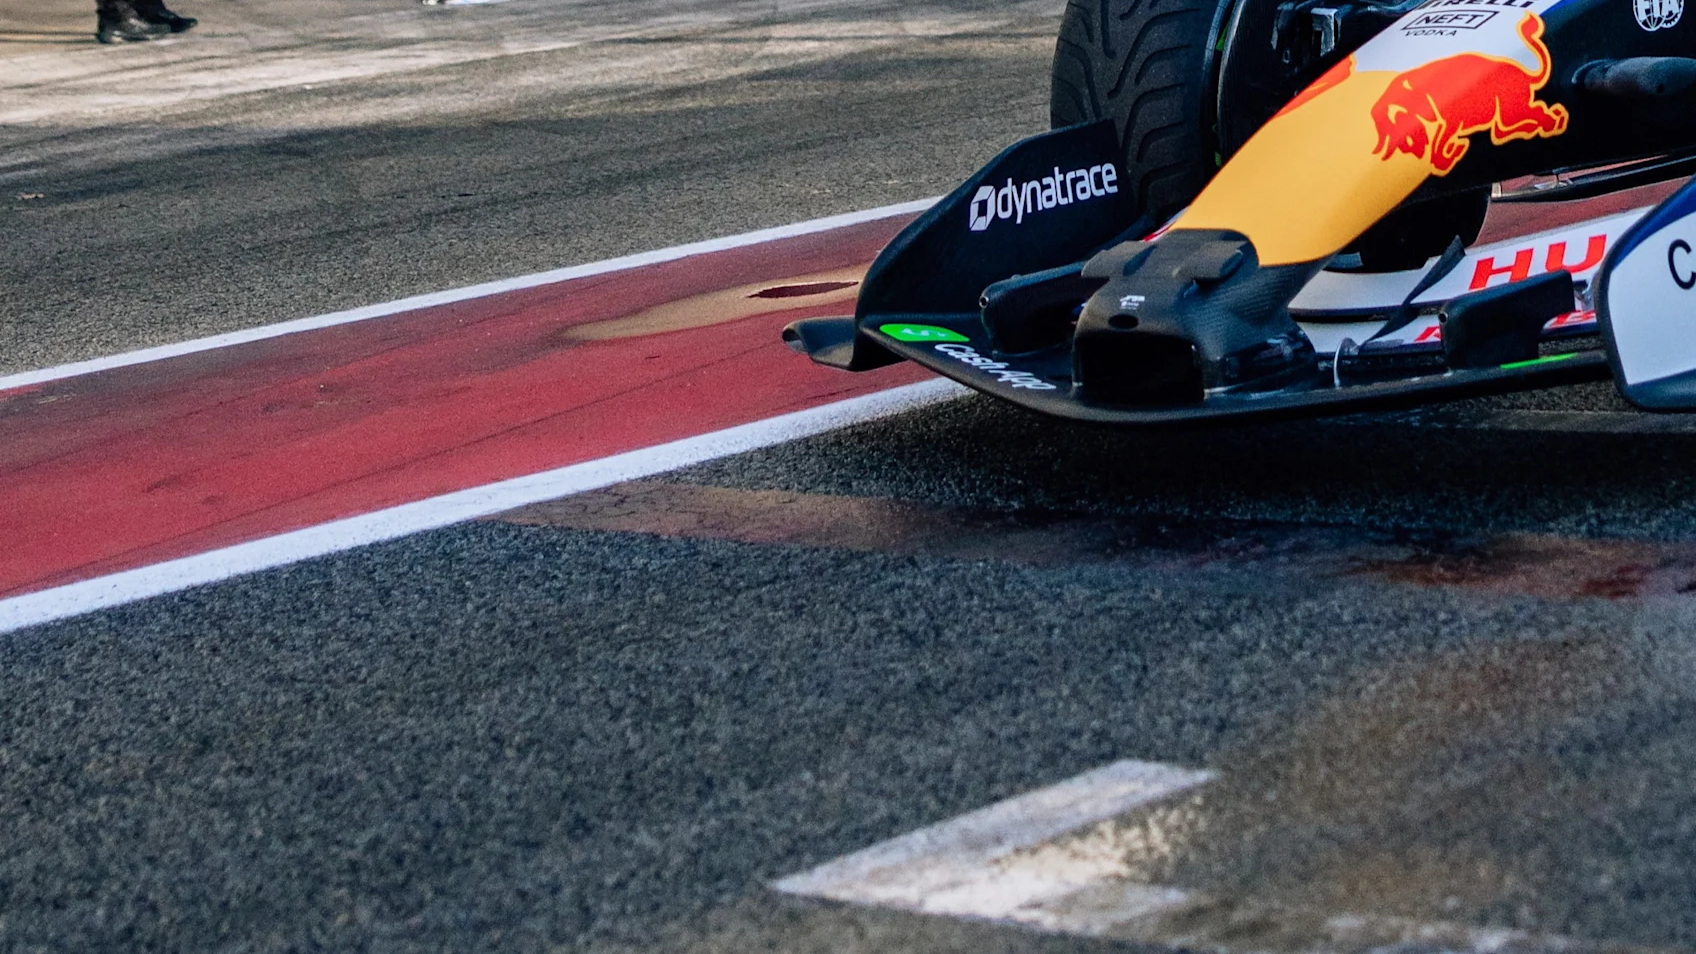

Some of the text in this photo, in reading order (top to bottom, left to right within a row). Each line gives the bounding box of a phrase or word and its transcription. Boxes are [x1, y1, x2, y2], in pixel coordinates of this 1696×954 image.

[1405, 29, 1458, 38] VODKA
[1416, 13, 1485, 25] NEFT
[997, 162, 1119, 225] dynatrace
[934, 342, 1057, 391] Cash App
